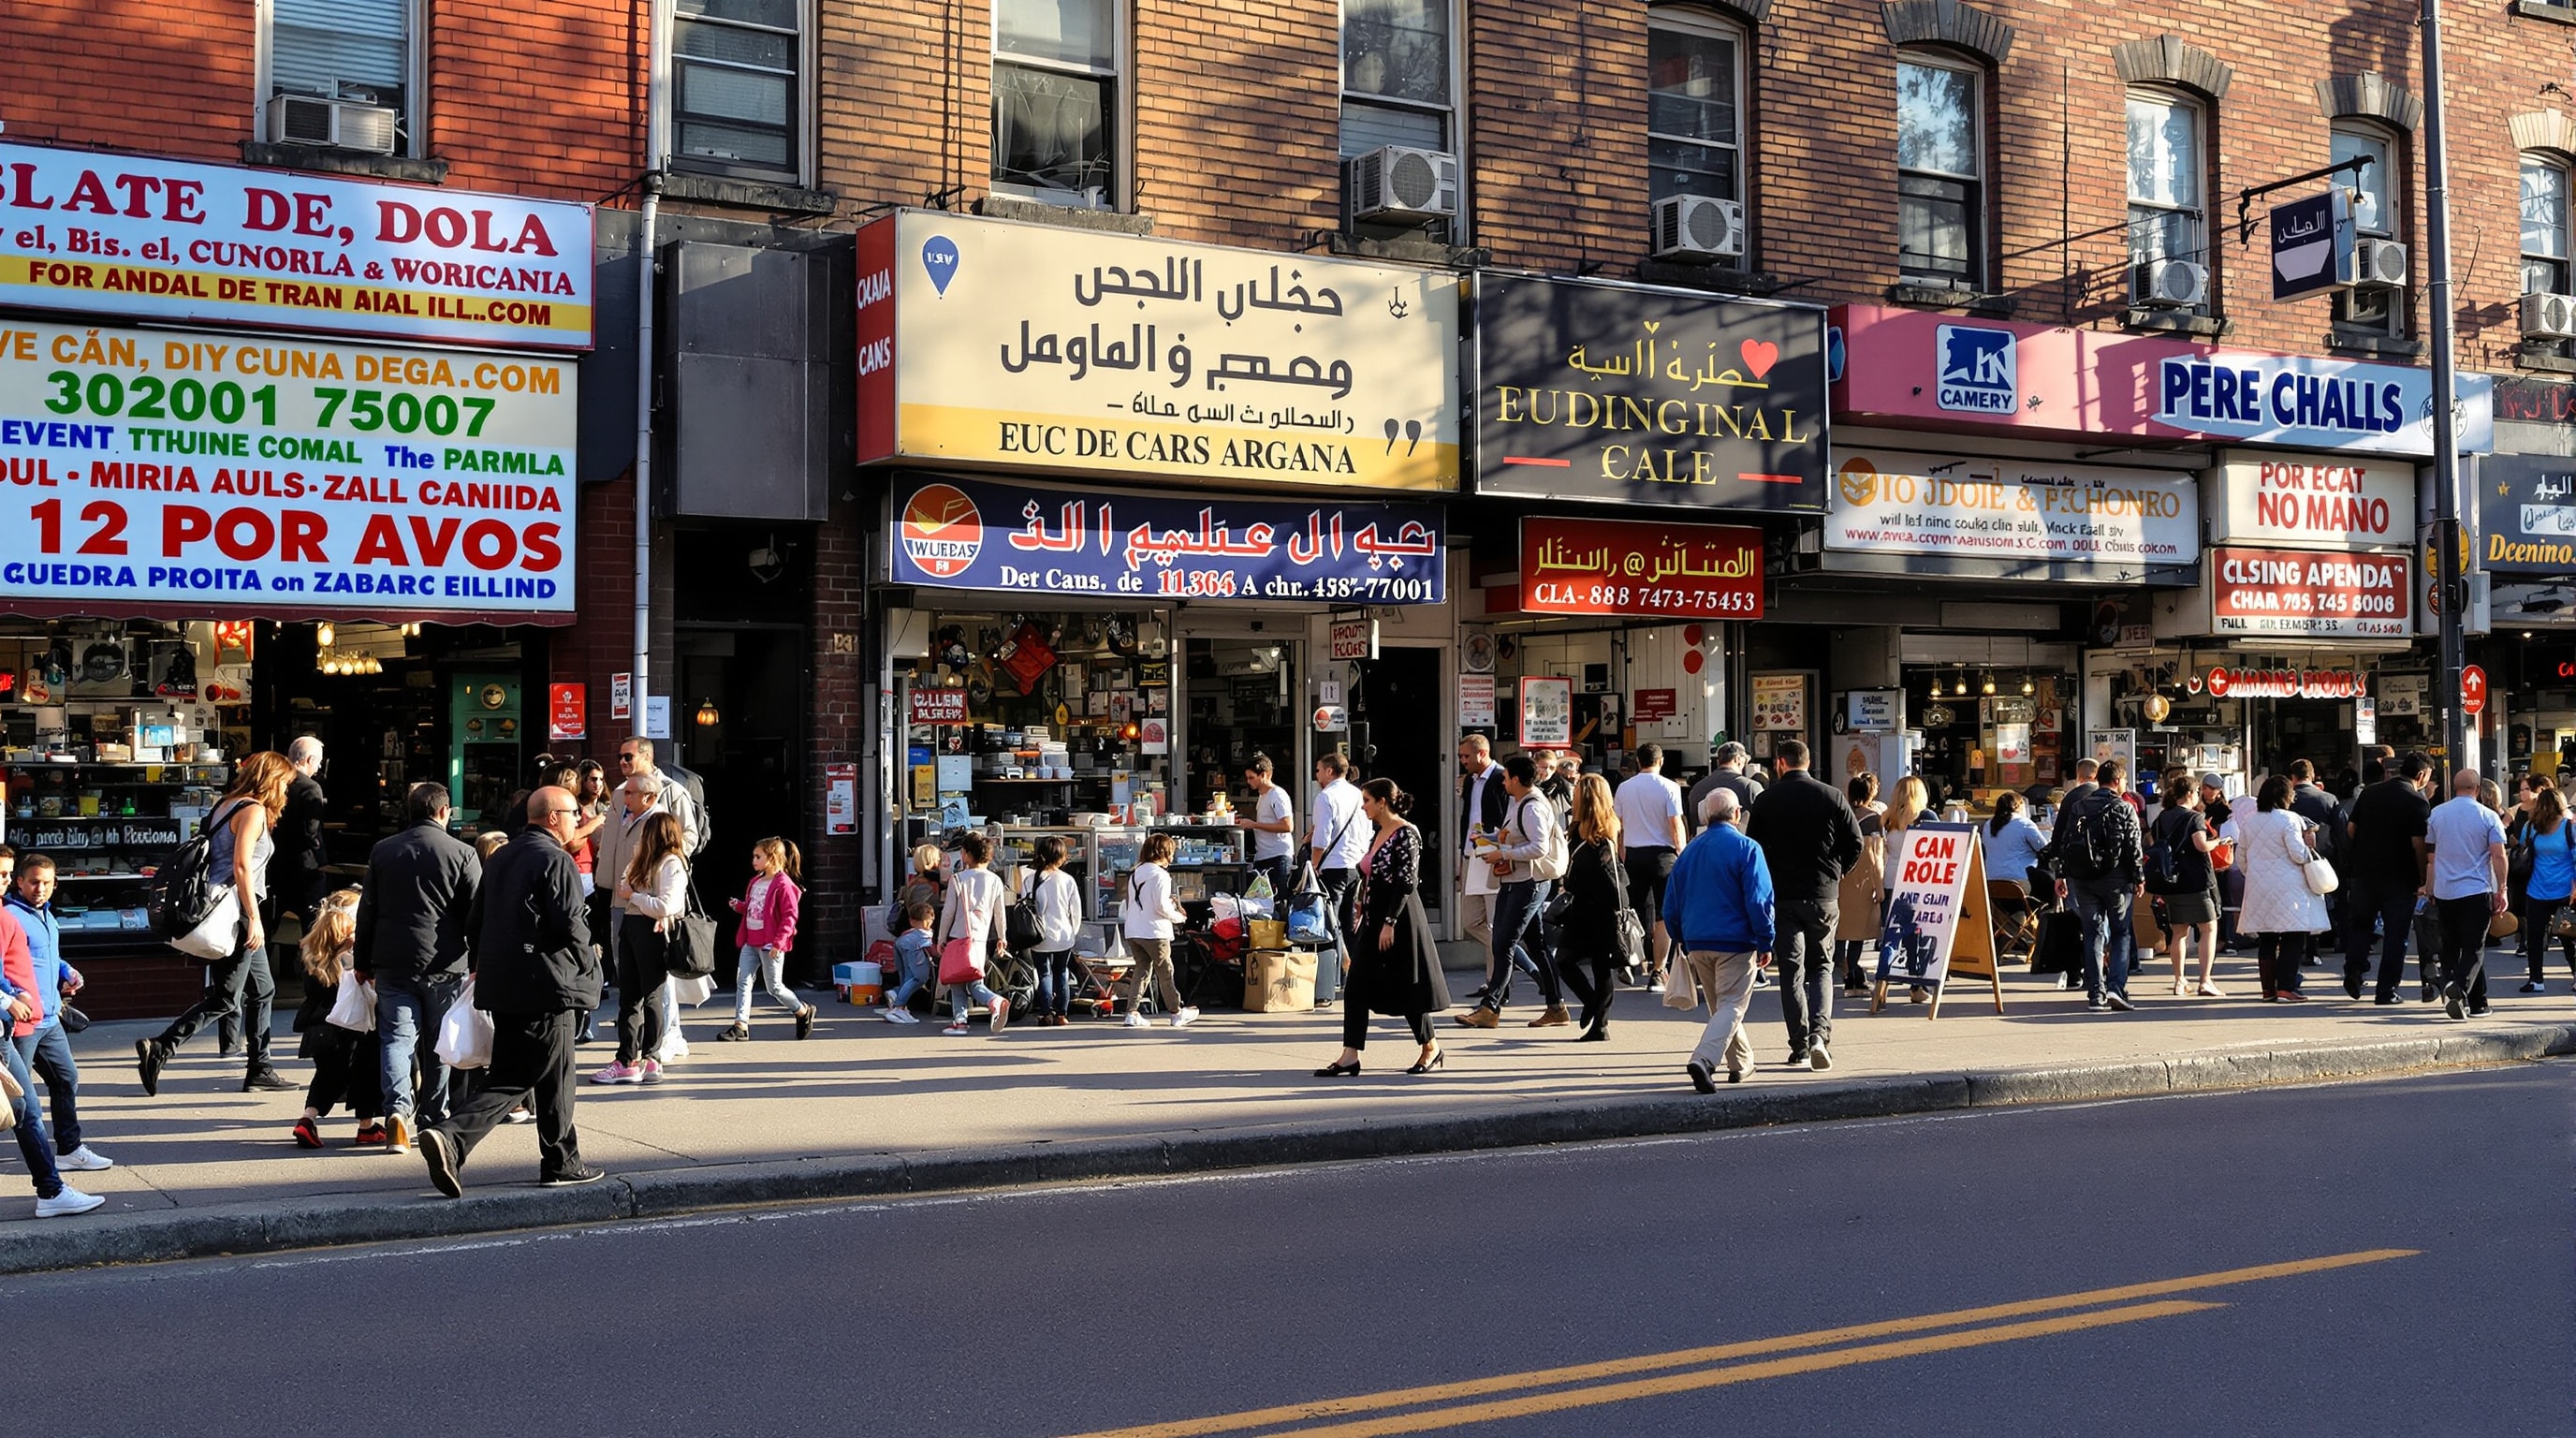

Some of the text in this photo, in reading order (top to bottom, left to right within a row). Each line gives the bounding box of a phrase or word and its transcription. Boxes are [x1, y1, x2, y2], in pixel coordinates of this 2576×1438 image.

[0, 163, 559, 257] LATE DE, DOLA
[15, 225, 56, 254] el,
[67, 227, 131, 257] Bis.
[140, 237, 180, 266] el,
[189, 240, 355, 277] CUNORLA
[363, 261, 384, 280] &
[391, 257, 576, 295] WORICANIA
[29, 261, 94, 288] FOR
[102, 269, 208, 298] ANDAL
[218, 278, 257, 301] DE
[265, 283, 343, 309] TRAN
[164, 341, 229, 373] DIY
[236, 346, 344, 380] CUNA
[858, 336, 891, 376] CANS
[44, 370, 496, 438] 302001 75007
[1495, 385, 1809, 444] EUDINGINAL
[1939, 389, 2012, 410] CAMERY
[2163, 361, 2404, 433] PERE CHALLS
[1, 419, 114, 449] EVENT
[257, 435, 363, 464] COMAL
[384, 445, 435, 469] The
[444, 448, 565, 477] PARMLA
[998, 421, 1357, 474] EUC DE CARS ARGANA
[90, 460, 200, 493] MIRIA
[2260, 461, 2366, 494] POR ECAT
[2257, 492, 2390, 535] NO MANO
[30, 497, 563, 573] 12 POR AVOS
[3, 562, 557, 598] GUEDRA PROITA on ZABARC EILLIND
[1117, 571, 1144, 592] de
[1241, 576, 1259, 595] A
[2222, 558, 2394, 589] CLSING APENDA
[1914, 836, 1956, 859] CAN
[1902, 860, 1958, 885] ROLE
